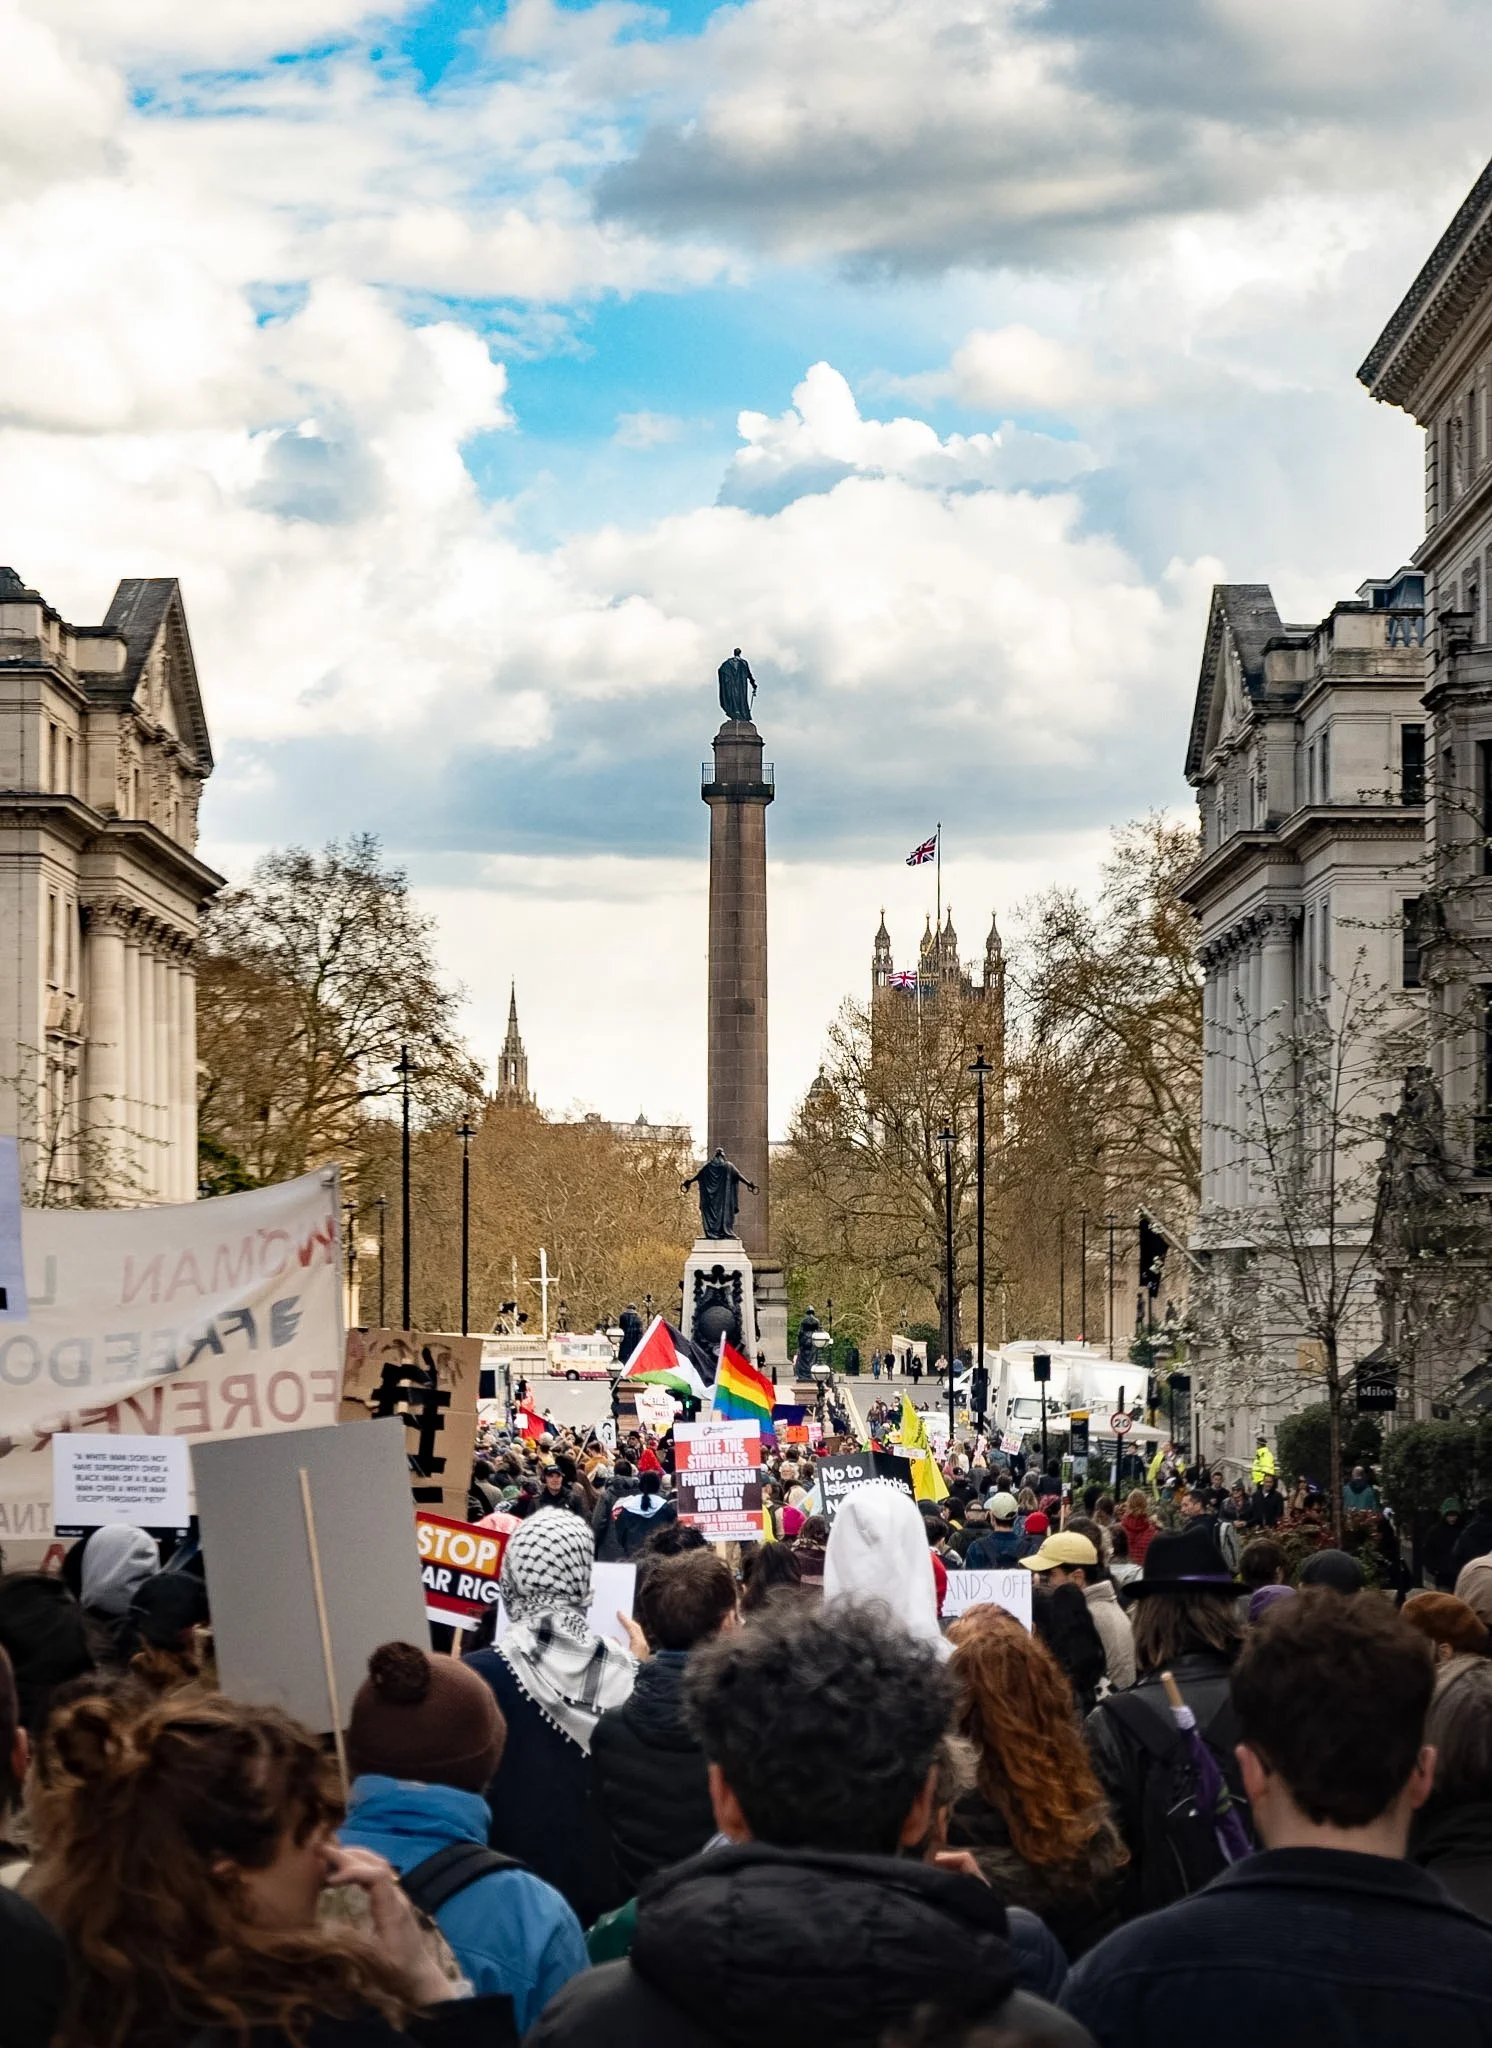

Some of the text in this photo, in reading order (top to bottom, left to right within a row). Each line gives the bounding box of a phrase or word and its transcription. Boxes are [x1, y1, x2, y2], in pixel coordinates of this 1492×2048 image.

[1359, 1386, 1394, 1397] Milos
[1115, 1418, 1130, 1428] 20
[690, 1438, 745, 1455] UNITE THE
[688, 1452, 749, 1469] STRUGGLES
[681, 1469, 757, 1487] FIGHT RACISM
[822, 1464, 863, 1481] No to
[694, 1485, 745, 1499] AUSTERITY
[697, 1497, 743, 1512] AND WAR
[417, 1524, 497, 1570] STOP
[420, 1565, 452, 1593] AR
[1002, 1574, 1030, 1599] OFF
